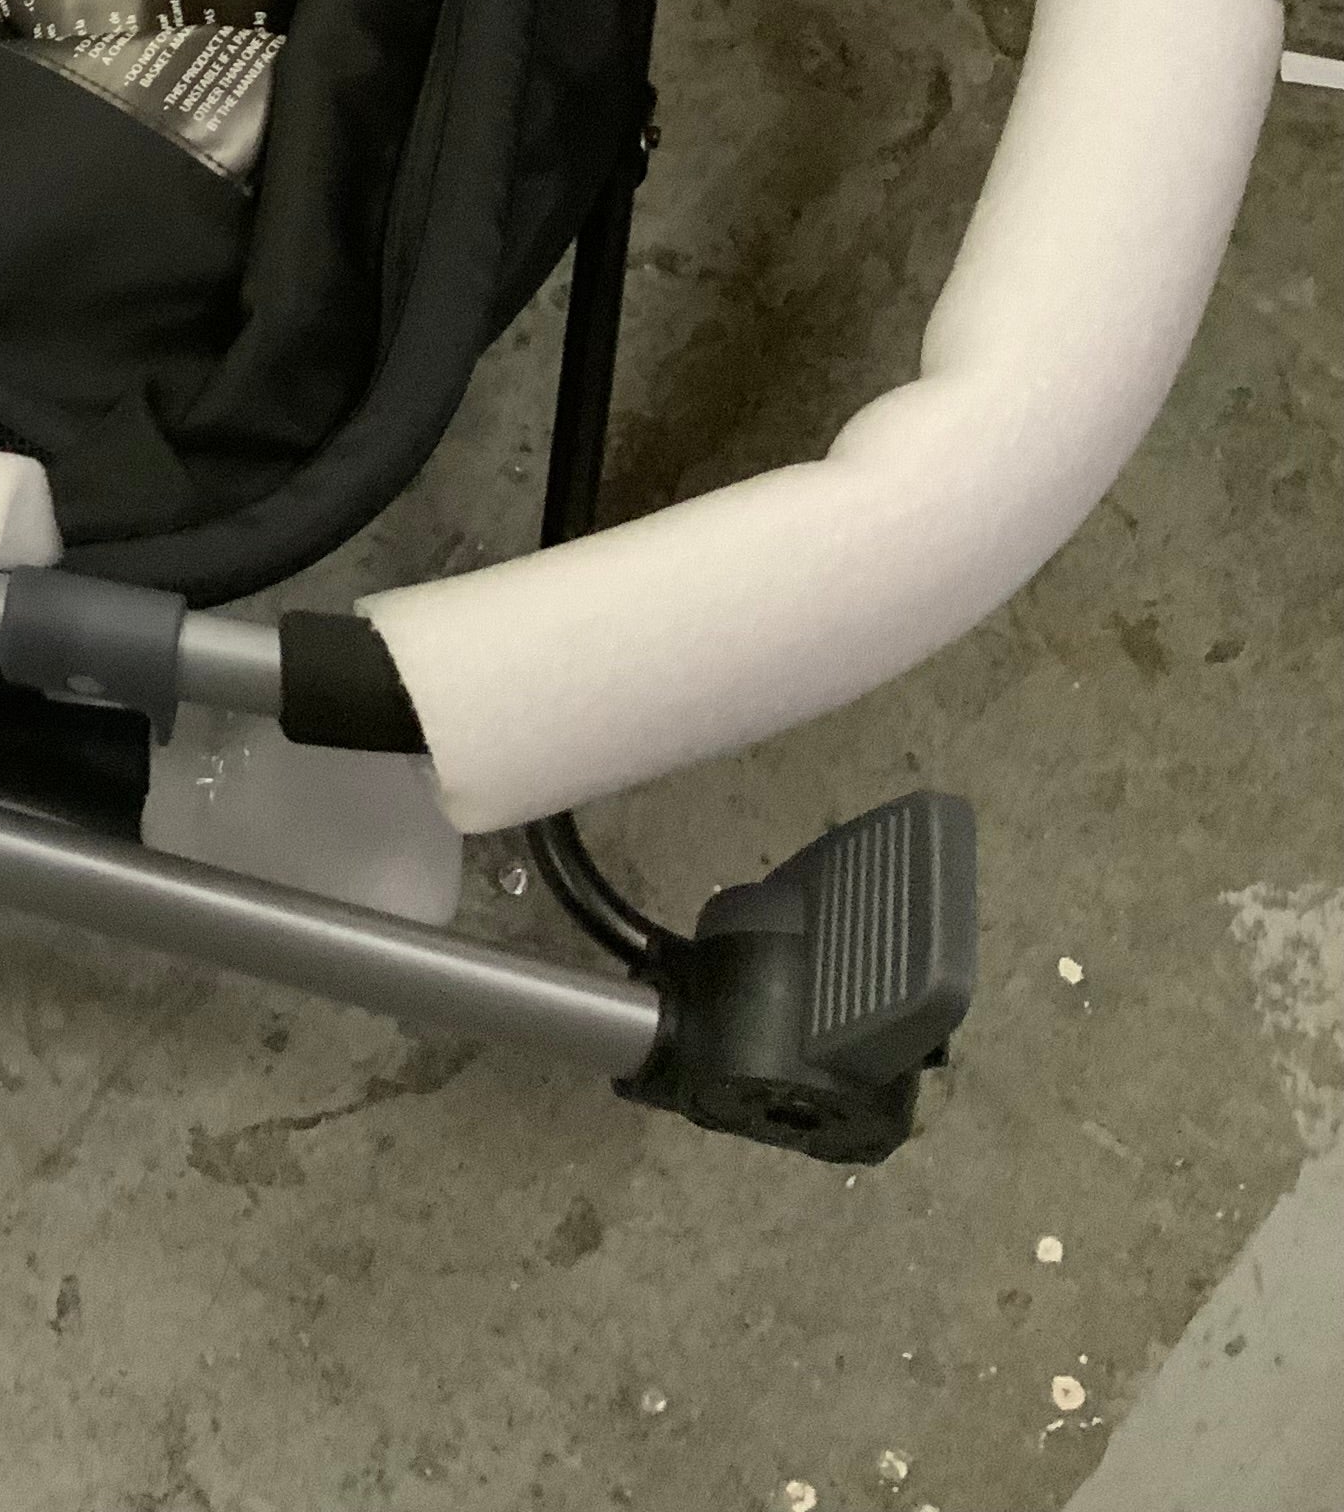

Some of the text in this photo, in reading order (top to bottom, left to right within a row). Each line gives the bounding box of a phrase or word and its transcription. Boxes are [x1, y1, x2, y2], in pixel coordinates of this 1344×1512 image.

[124, 40, 160, 82] DO NOT
[162, 33, 223, 105] THIS PRODUCT
[178, 42, 239, 112] UNSTABLE IF A
[192, 85, 225, 121] OTHER
[217, 57, 246, 88] THAN
[240, 36, 264, 61] ONE
[206, 113, 222, 132] BY
[215, 93, 239, 116] THE
